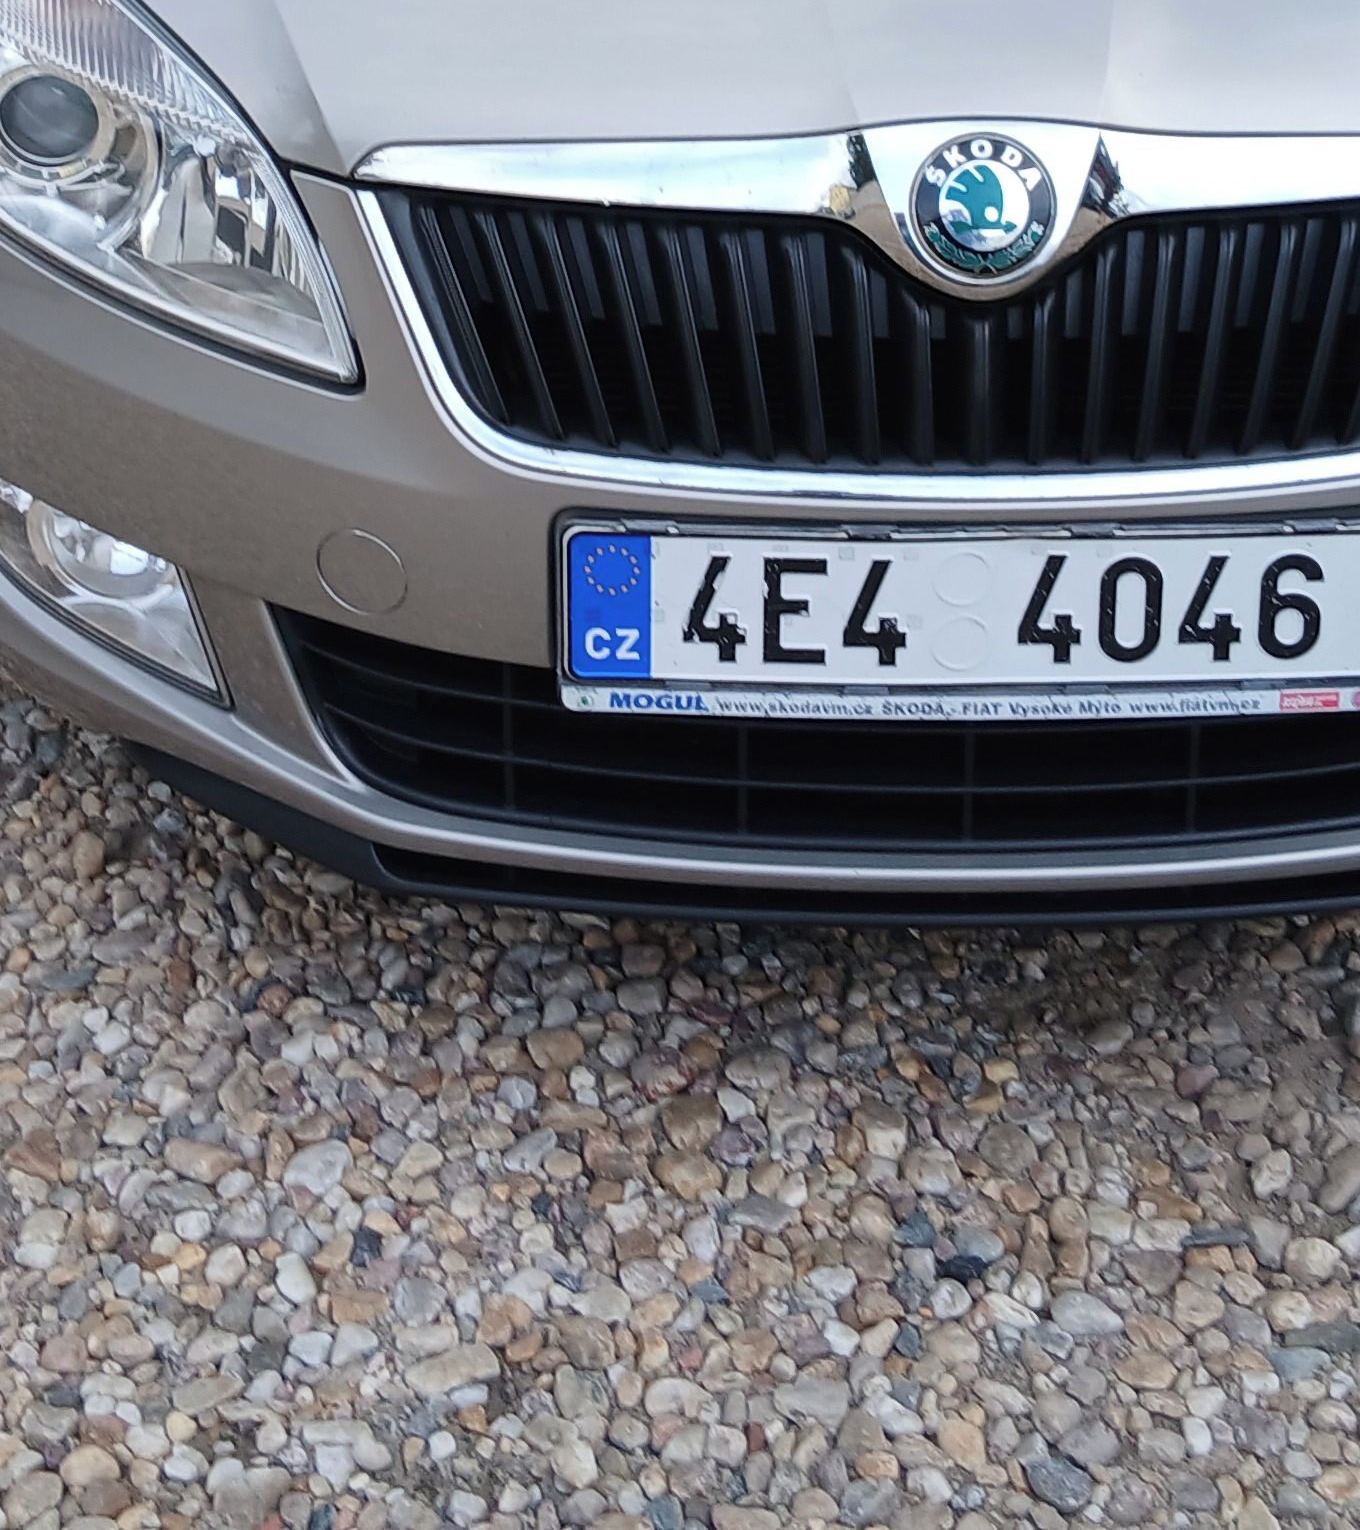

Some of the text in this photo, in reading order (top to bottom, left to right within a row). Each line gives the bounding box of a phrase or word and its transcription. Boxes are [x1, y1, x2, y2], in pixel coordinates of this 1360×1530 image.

[682, 553, 1325, 666] 4E4 4046
[584, 626, 641, 661] CZ
[609, 691, 710, 712] MOGUL
[962, 701, 1003, 716] FIAT
